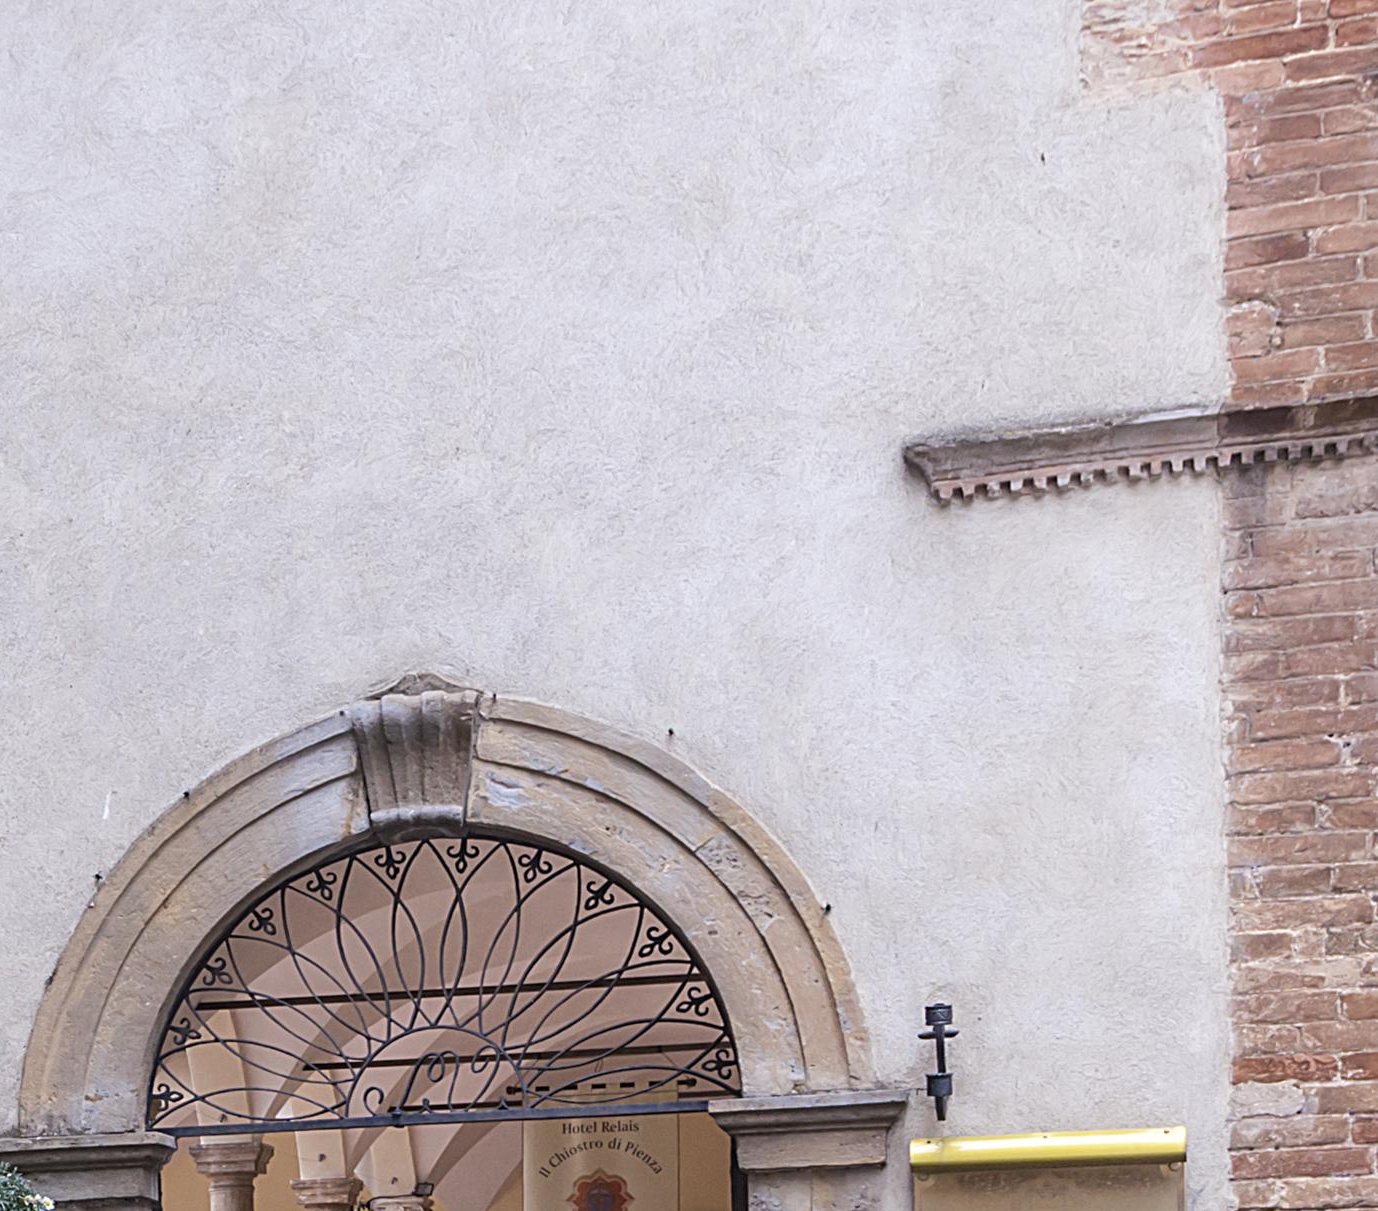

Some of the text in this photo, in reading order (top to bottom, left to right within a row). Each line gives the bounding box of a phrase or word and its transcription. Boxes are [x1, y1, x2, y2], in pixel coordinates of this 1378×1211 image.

[562, 1121, 639, 1134] Hotel Relais
[538, 1138, 663, 1178] Il Chiostro di Pienza
